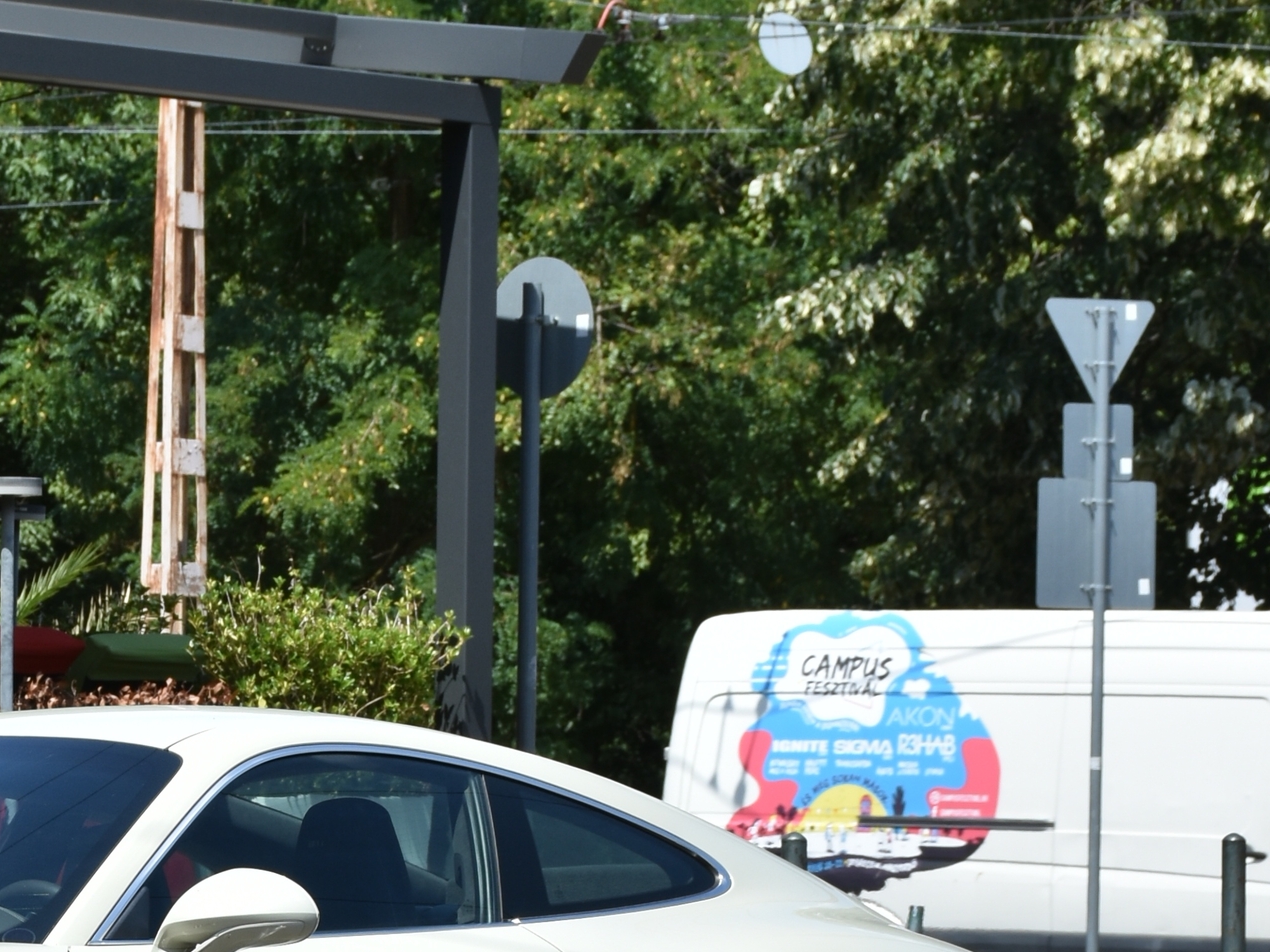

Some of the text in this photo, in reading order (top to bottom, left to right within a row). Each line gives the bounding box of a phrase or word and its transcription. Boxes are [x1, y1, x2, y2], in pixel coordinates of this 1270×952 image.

[801, 654, 893, 681] CAMPUS
[886, 705, 956, 728] AKON
[772, 739, 829, 753] IGNITE
[833, 739, 893, 755] SIGMA
